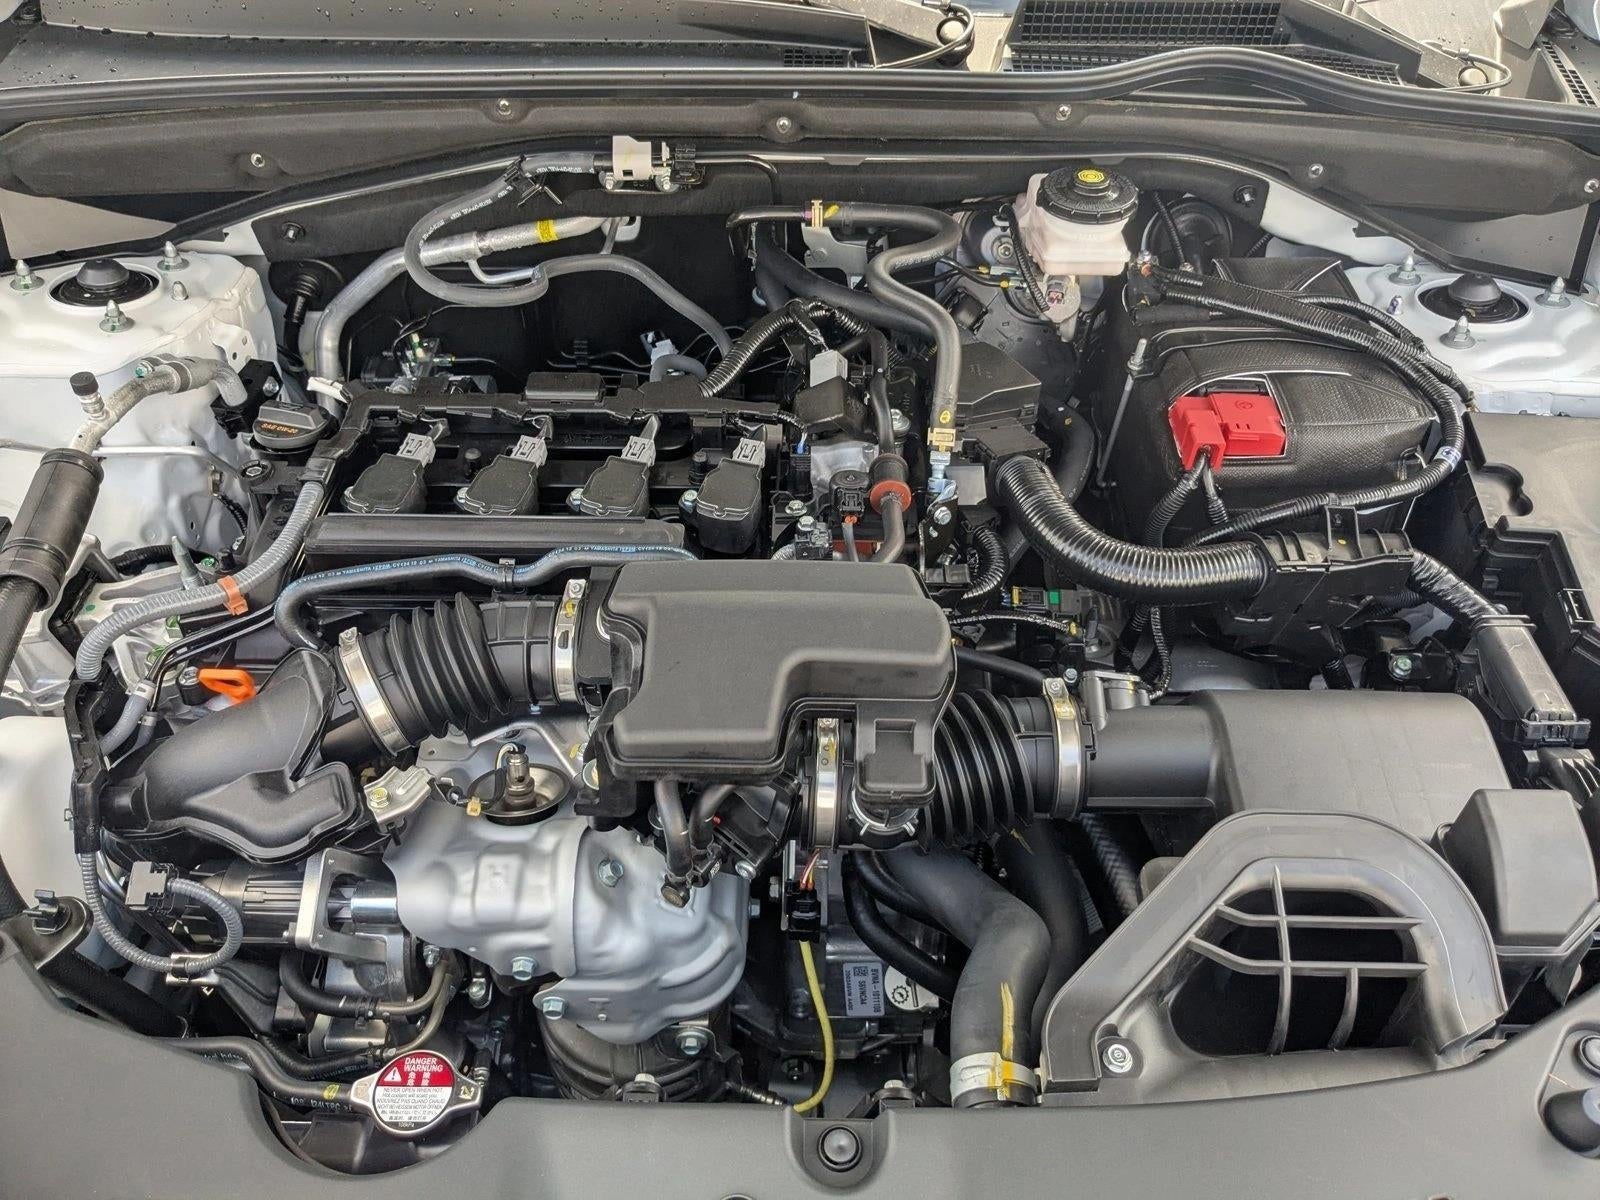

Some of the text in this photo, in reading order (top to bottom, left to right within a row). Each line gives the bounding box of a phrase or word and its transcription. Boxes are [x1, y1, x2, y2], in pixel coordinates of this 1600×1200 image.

[277, 426, 299, 434] 0W-20
[404, 1057, 437, 1065] DANGER
[403, 1064, 443, 1072] WARNUNG
